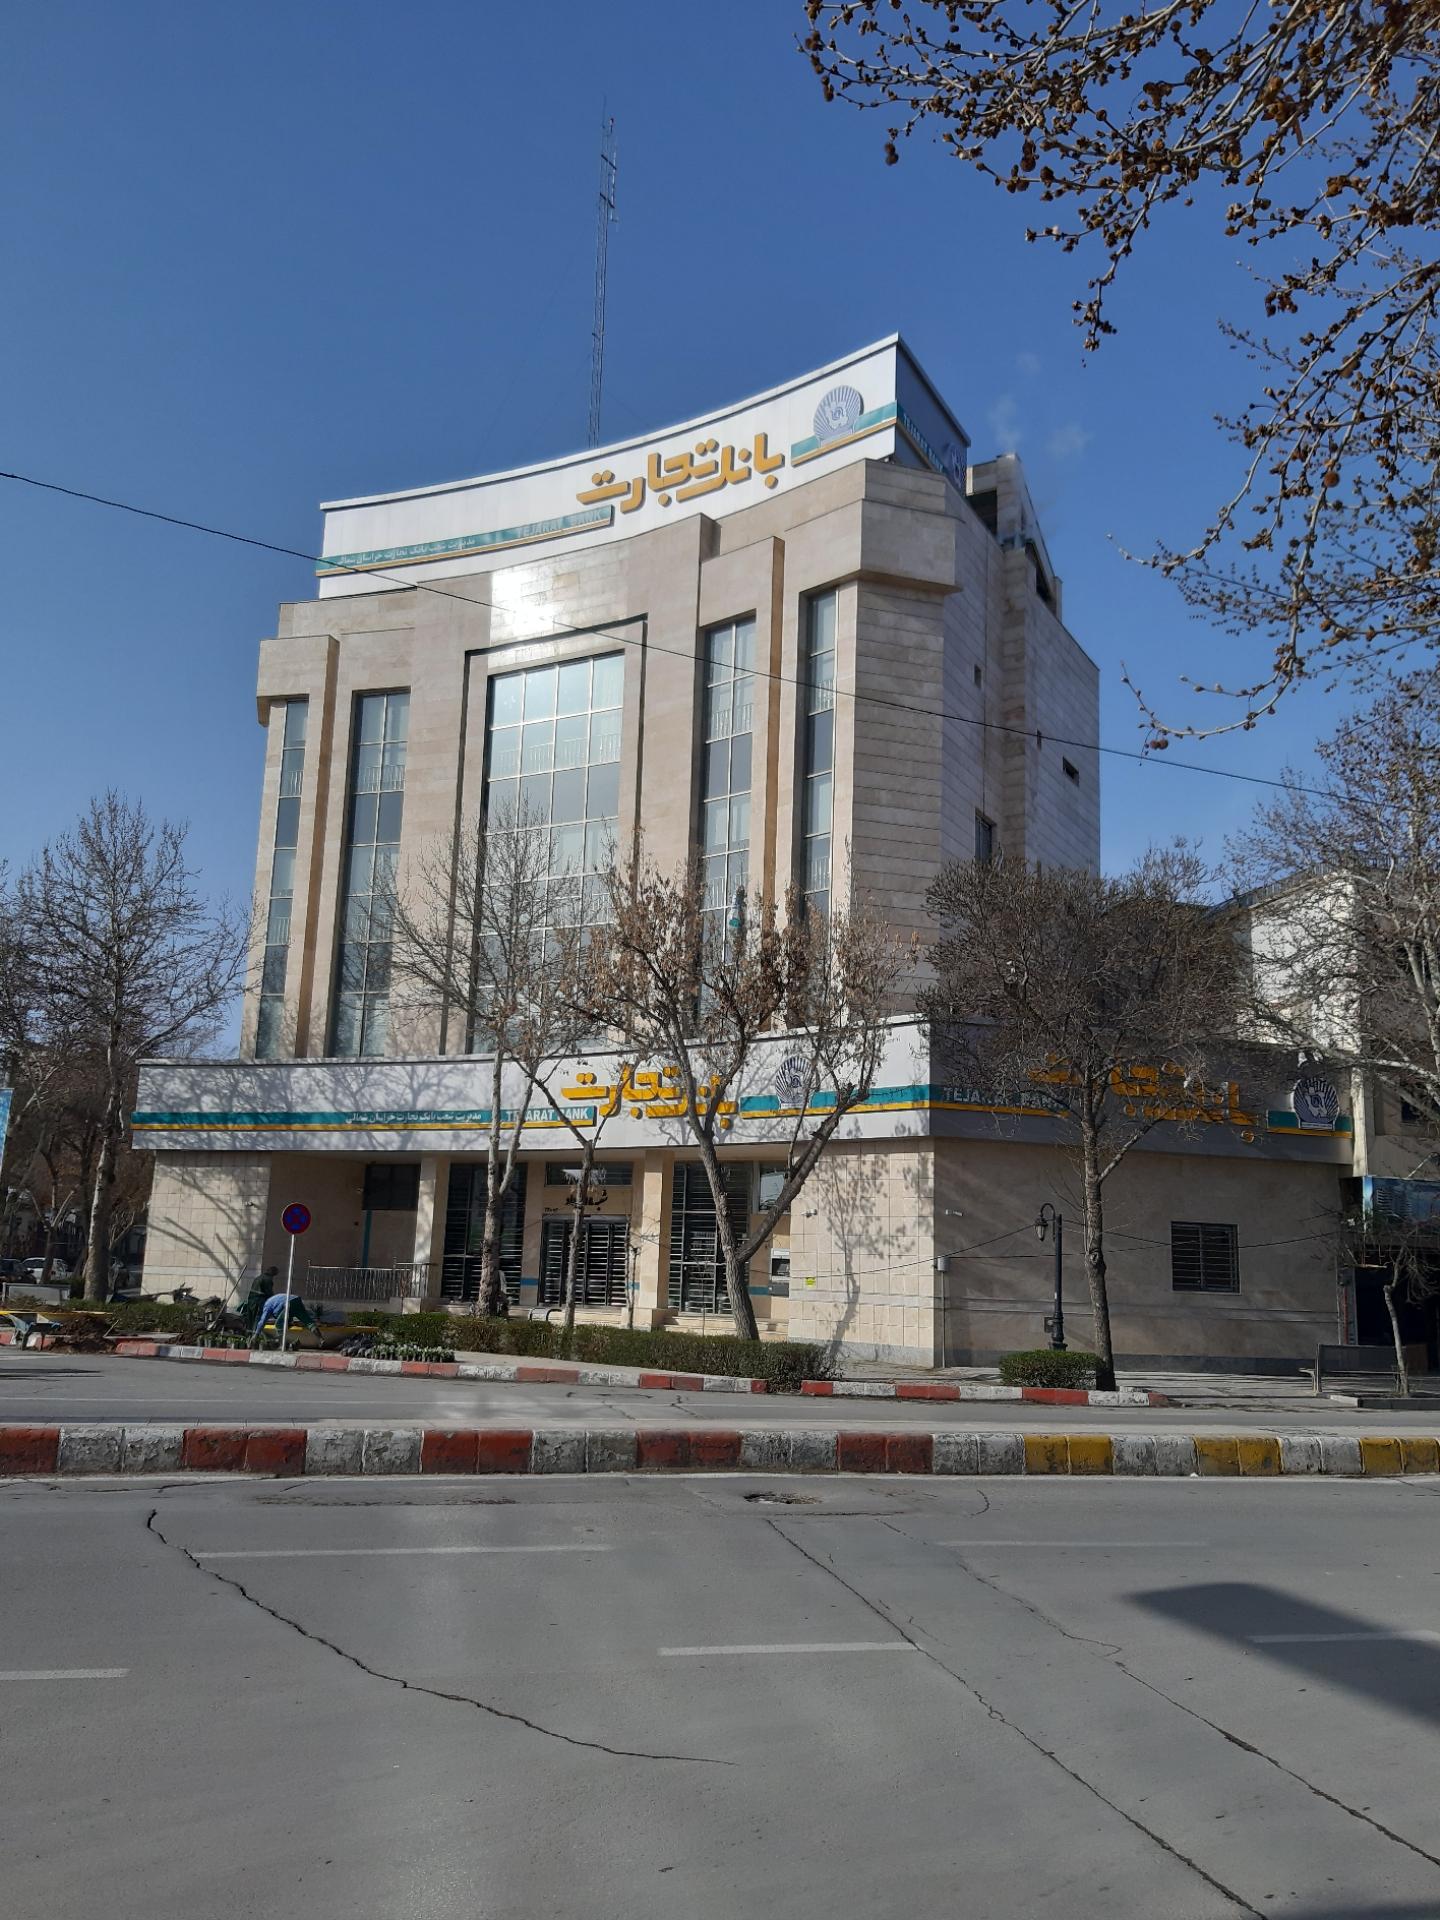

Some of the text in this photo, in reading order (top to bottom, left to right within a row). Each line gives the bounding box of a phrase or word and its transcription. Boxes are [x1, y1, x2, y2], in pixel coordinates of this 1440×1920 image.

[576, 432, 785, 514] بانک تجارت
[506, 1109, 555, 1122] TEARAT
[561, 1065, 683, 1119] تجارت
